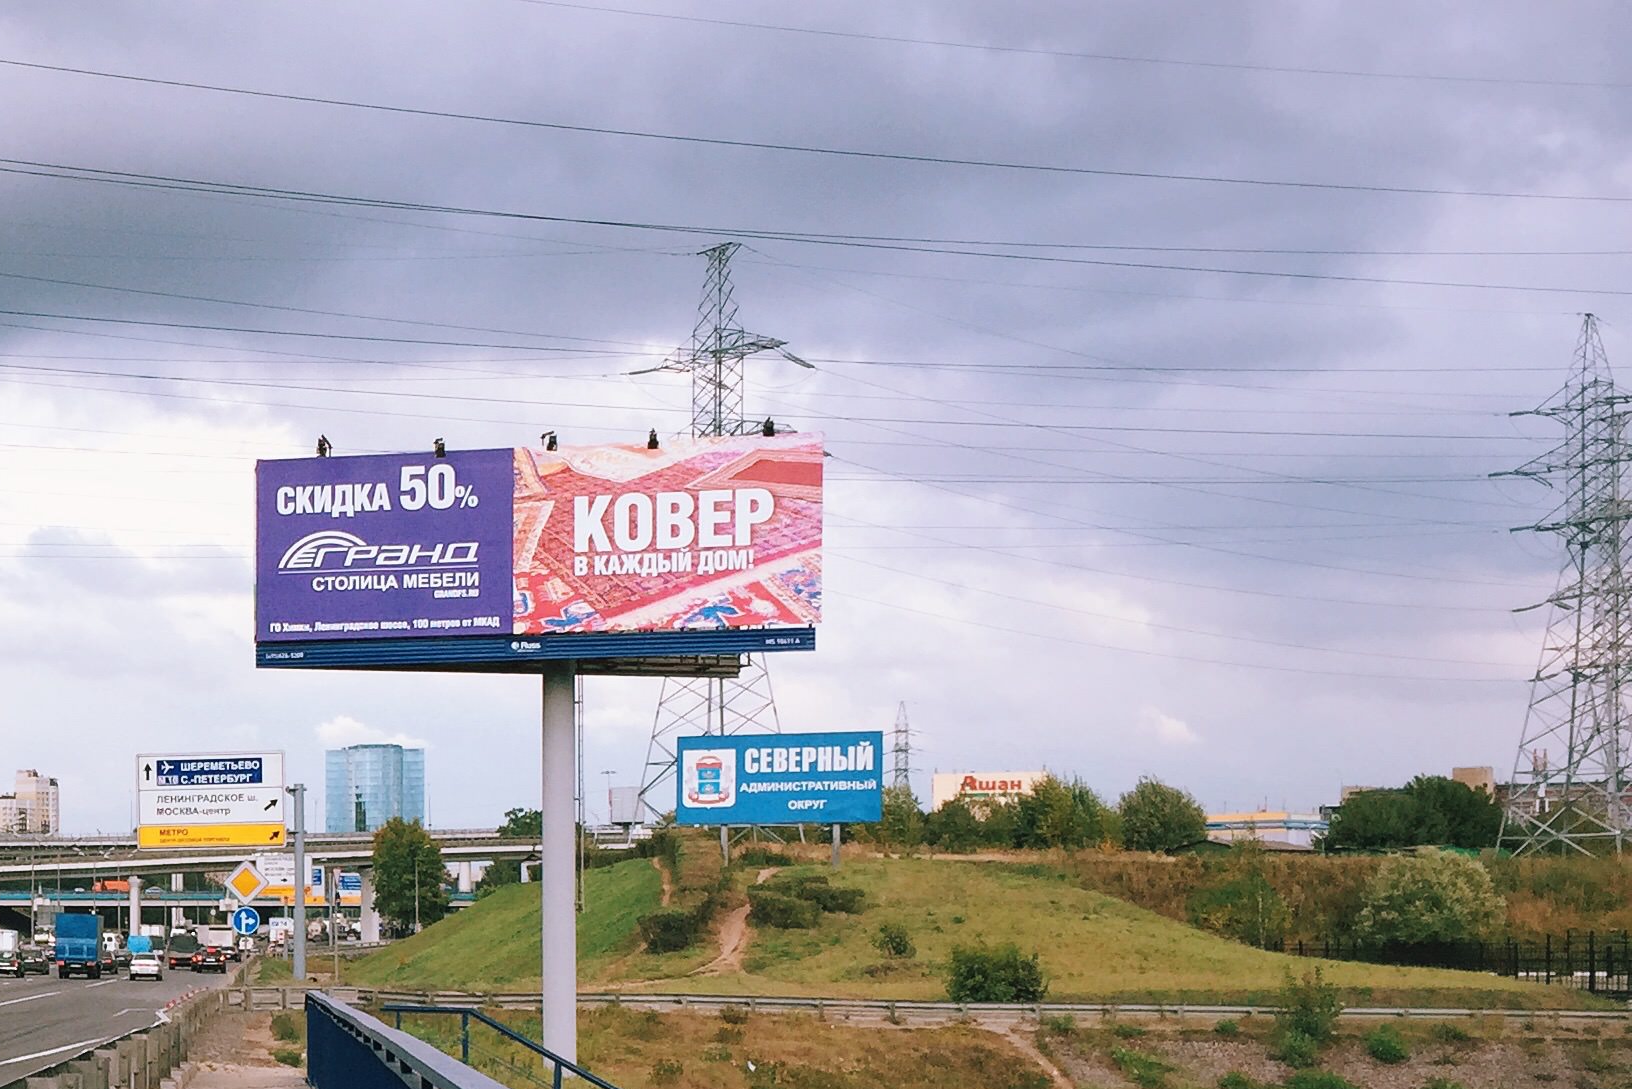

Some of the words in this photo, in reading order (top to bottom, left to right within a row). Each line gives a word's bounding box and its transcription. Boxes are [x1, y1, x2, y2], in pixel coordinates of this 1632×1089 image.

[277, 483, 391, 517] СКИДКА
[399, 464, 479, 510] 50%
[574, 488, 775, 553] КОВЕР
[574, 557, 588, 576] В
[594, 548, 692, 577] КАЖДЫЙ
[697, 550, 754, 575] ДОМ!
[312, 574, 399, 592] СТОЛИЦА
[402, 572, 479, 589] МЕБЕЛИ
[269, 622, 281, 633] ГО
[412, 618, 429, 629] 100
[461, 619, 473, 628] от
[473, 616, 500, 628] МКАД
[744, 741, 874, 774] СЕВЕРНЫЙ
[180, 760, 260, 772] ШЕРЕМЕТЬЕВО
[740, 778, 877, 793] АДМИНИСТРАТИВНЫЙ
[960, 775, 1022, 791] Ашан
[156, 793, 245, 804] ЛЕНИНГРАДСКОЕ
[787, 798, 828, 811] ОКРУГ
[156, 807, 231, 817] МОСКВА-центр
[159, 828, 189, 836] МЕТРО
